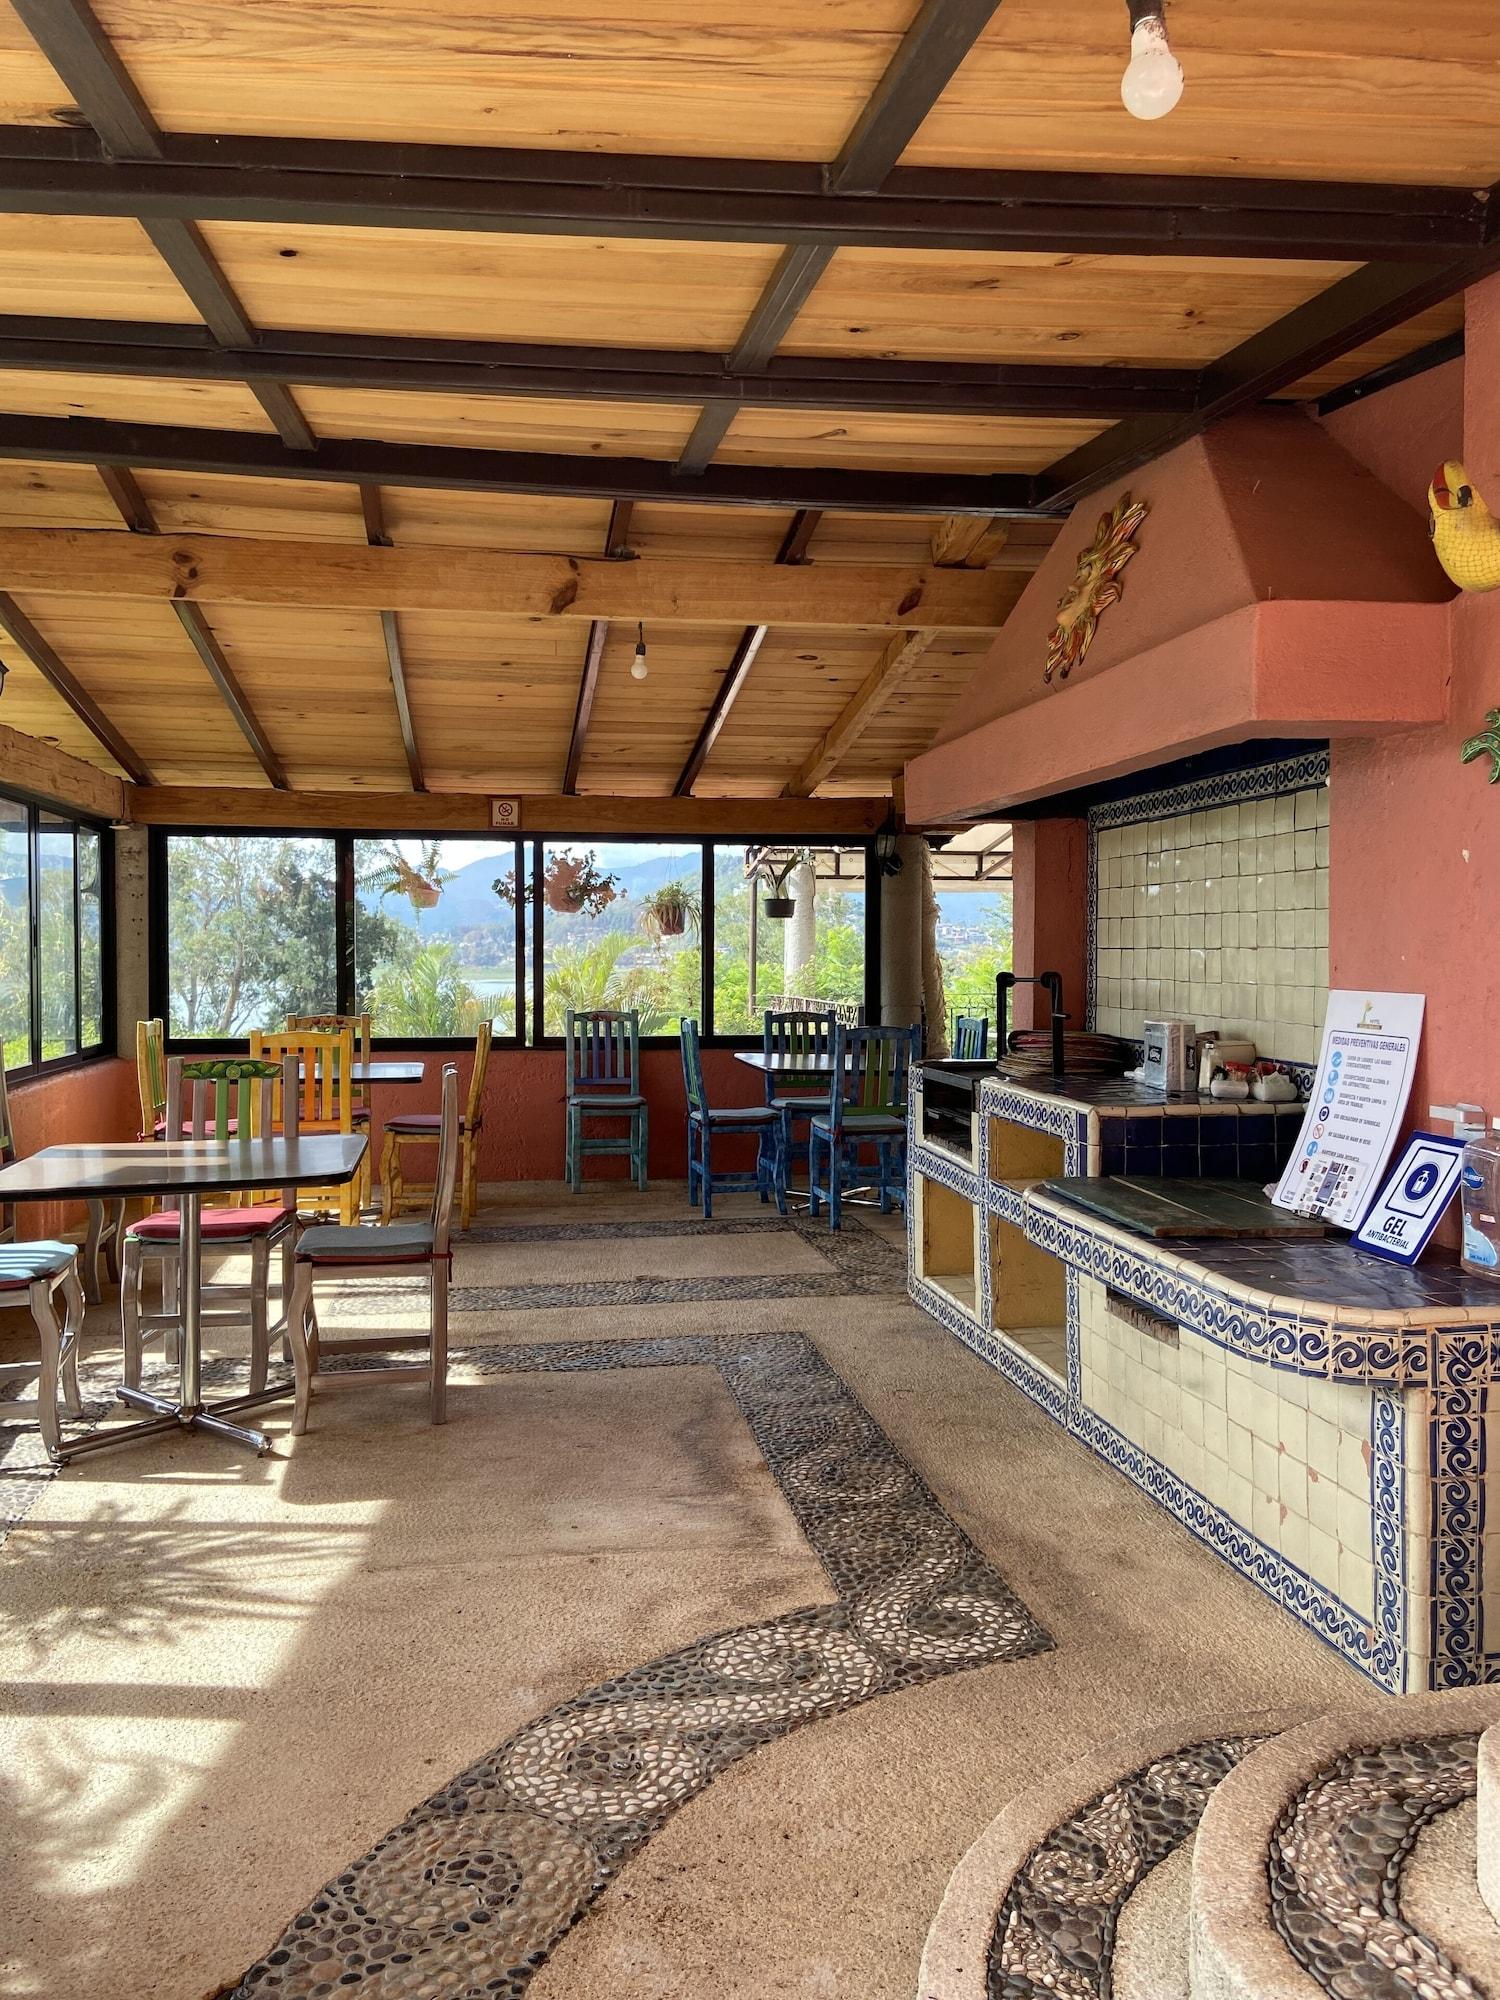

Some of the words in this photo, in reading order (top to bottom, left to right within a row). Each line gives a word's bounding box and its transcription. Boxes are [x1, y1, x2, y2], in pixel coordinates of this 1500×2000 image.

[1332, 1036, 1350, 1046] MEDIDAS
[1350, 1038, 1378, 1049] PREVENTIVAS
[1379, 1041, 1405, 1052] GENERALES
[1383, 1216, 1407, 1236] GEL
[1366, 1229, 1409, 1249] ANTIBACTERIAL
